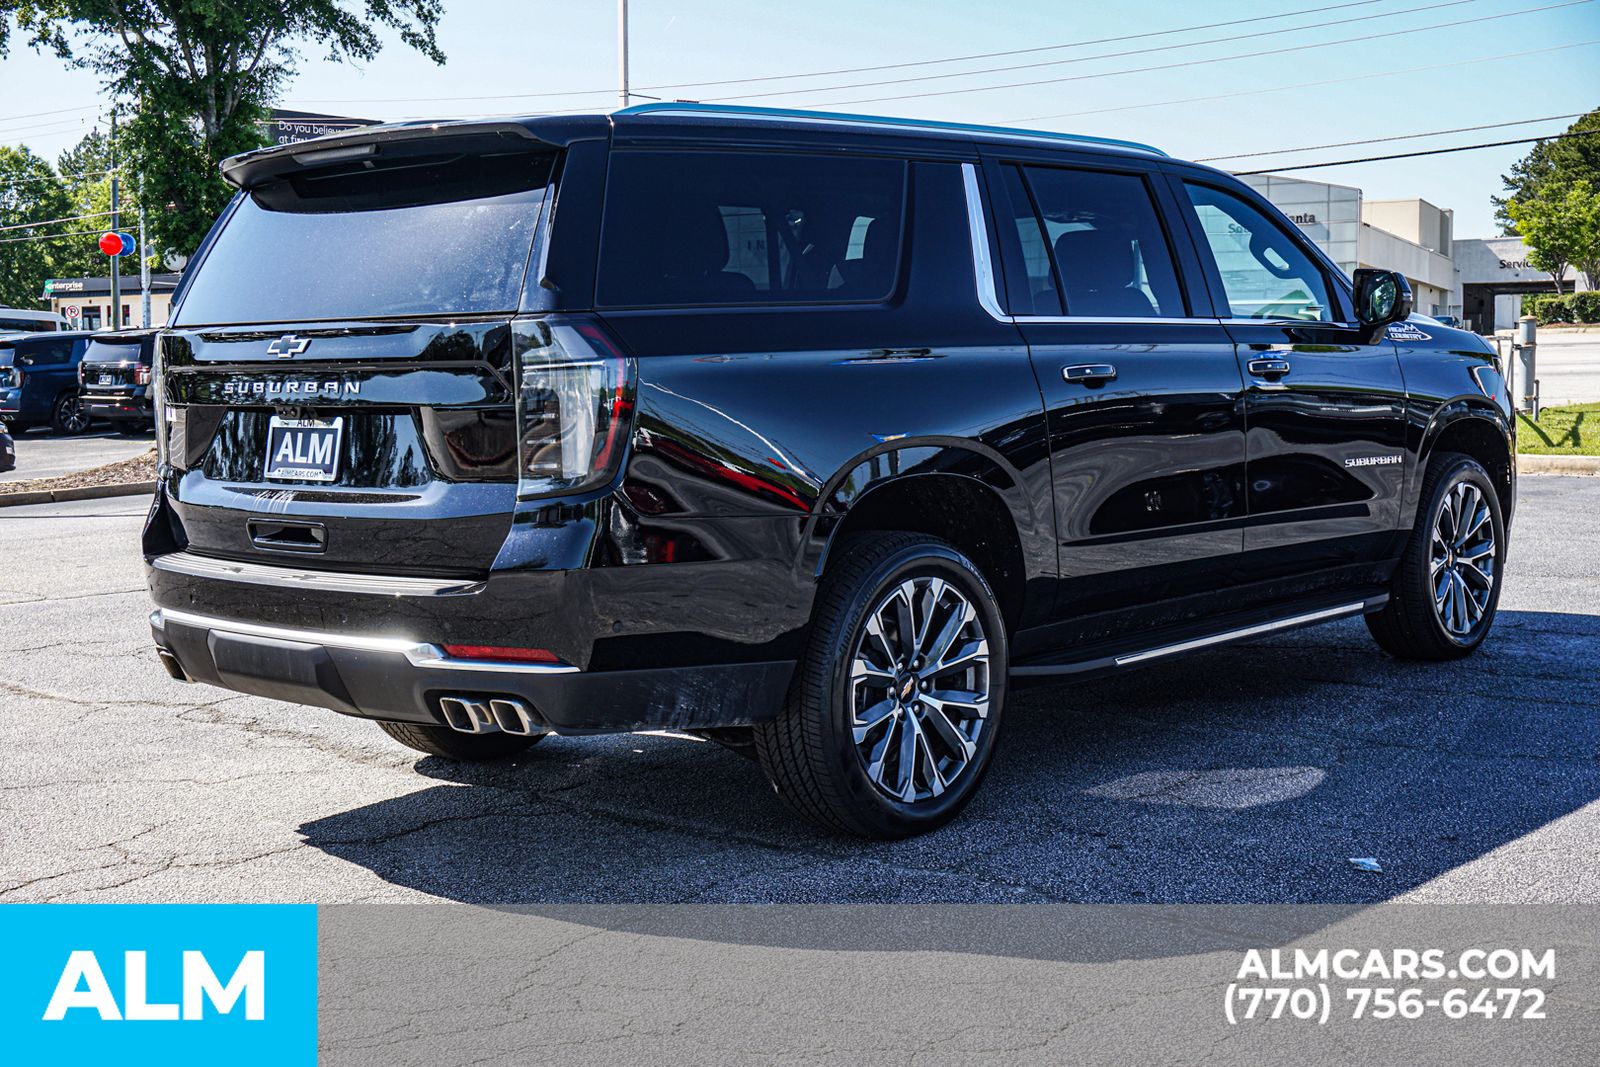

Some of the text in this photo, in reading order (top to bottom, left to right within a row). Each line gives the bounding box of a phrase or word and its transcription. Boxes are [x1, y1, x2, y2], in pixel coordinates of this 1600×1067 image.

[278, 121, 292, 131] Do
[294, 124, 311, 134] you
[46, 280, 83, 291] enterprise
[224, 381, 361, 394] SUBURBAN
[296, 419, 315, 428] ALM
[275, 431, 334, 465] ALM
[1344, 455, 1402, 468] SUBURBAN
